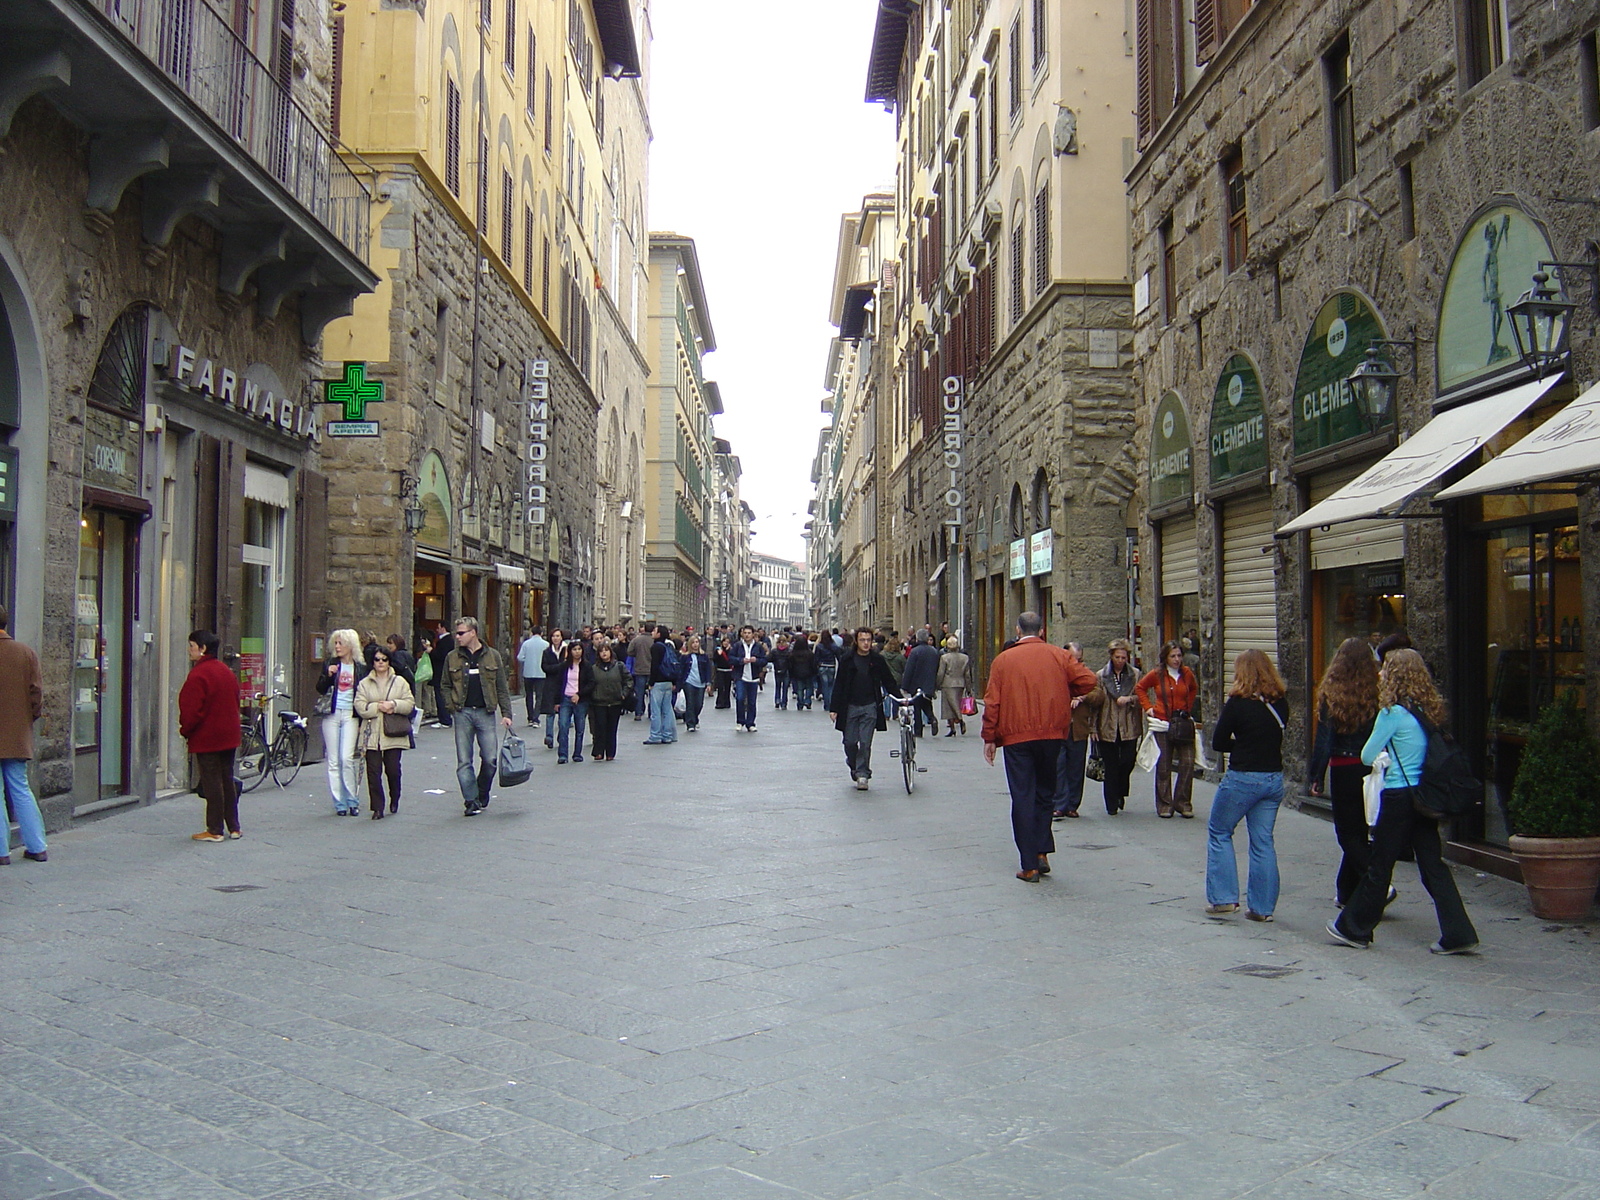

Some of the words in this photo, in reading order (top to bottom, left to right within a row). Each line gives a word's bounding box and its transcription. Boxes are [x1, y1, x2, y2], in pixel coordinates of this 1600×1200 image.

[171, 345, 321, 444] FARMACIA
[1212, 414, 1264, 457] CLEMENTE
[1151, 447, 1190, 482] CLEMENTE
